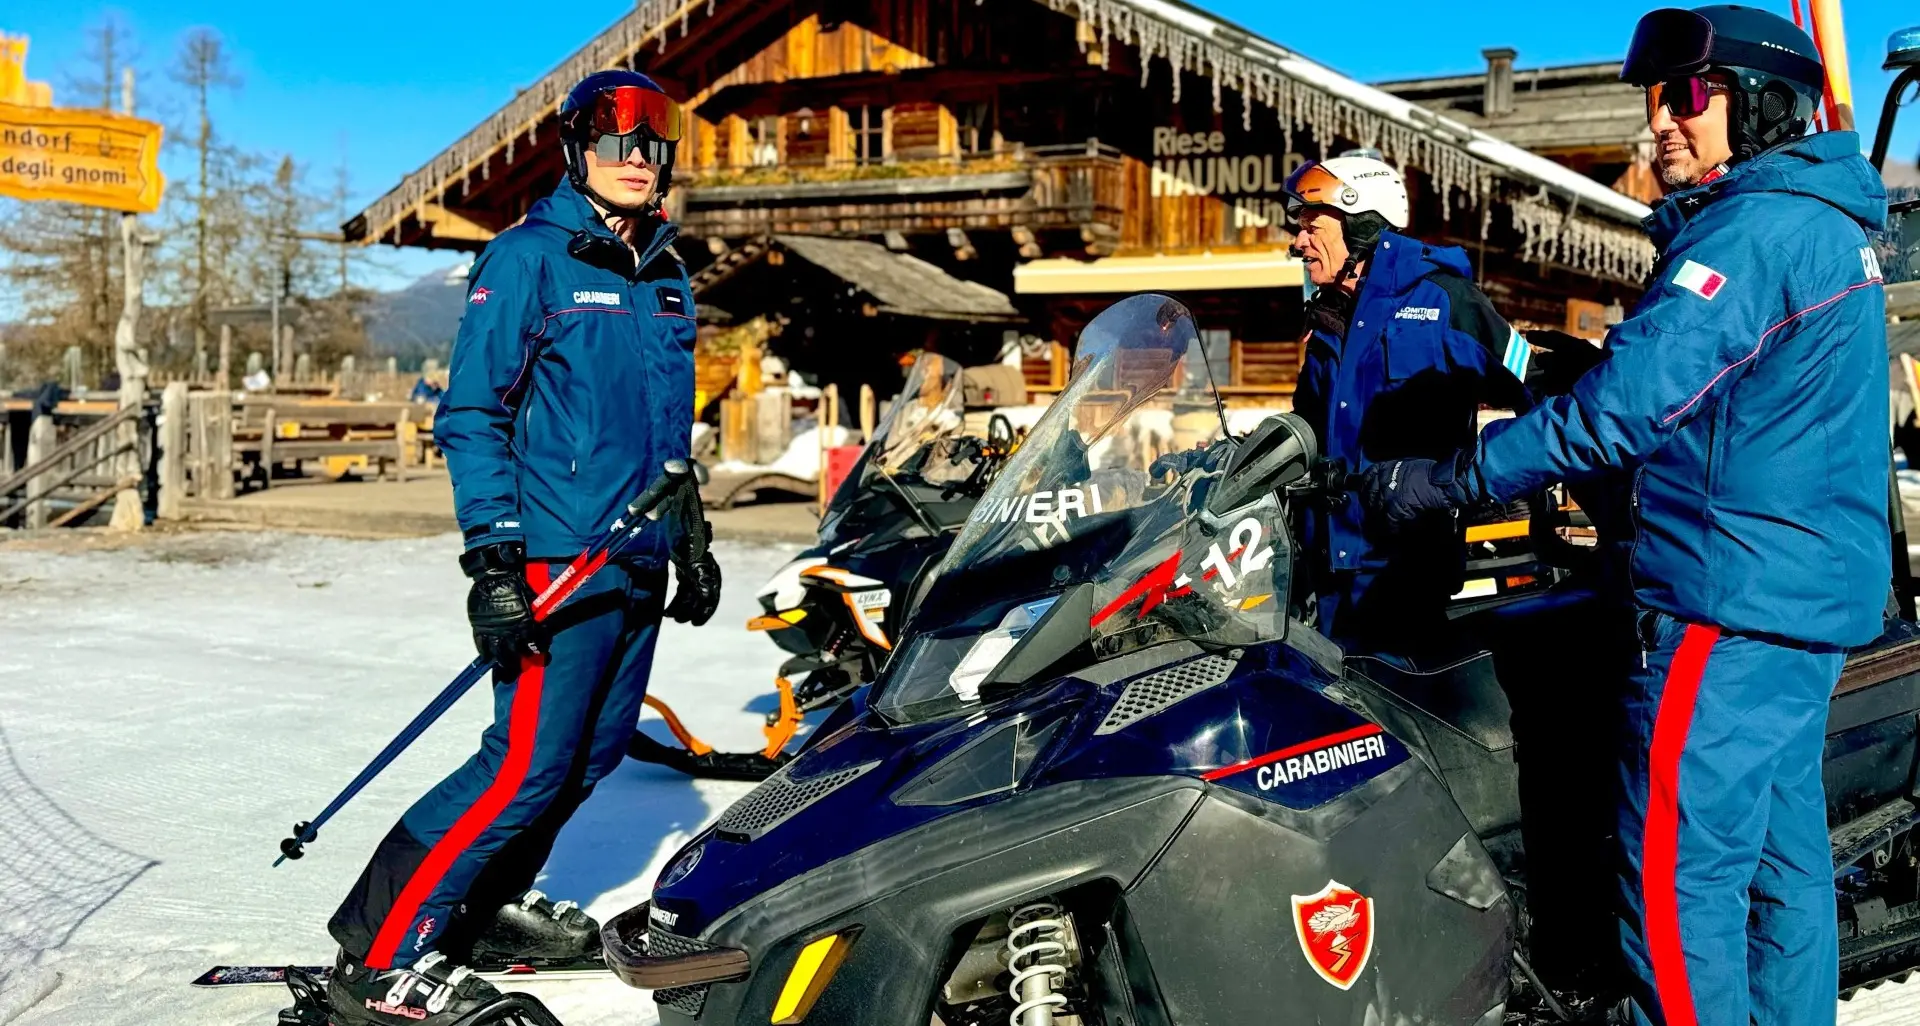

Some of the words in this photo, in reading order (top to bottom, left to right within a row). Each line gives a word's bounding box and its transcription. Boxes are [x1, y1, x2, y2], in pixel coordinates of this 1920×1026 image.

[4, 128, 72, 153] ndorf
[1153, 126, 1225, 156] Riese
[2, 157, 54, 180] degli
[62, 165, 127, 184] gnomi
[1353, 171, 1390, 181] HEAD
[573, 291, 621, 305] CARABINIERI
[857, 591, 885, 604] LYNX
[1256, 734, 1387, 791] CARABINIERI
[365, 998, 427, 1020] HEAD
